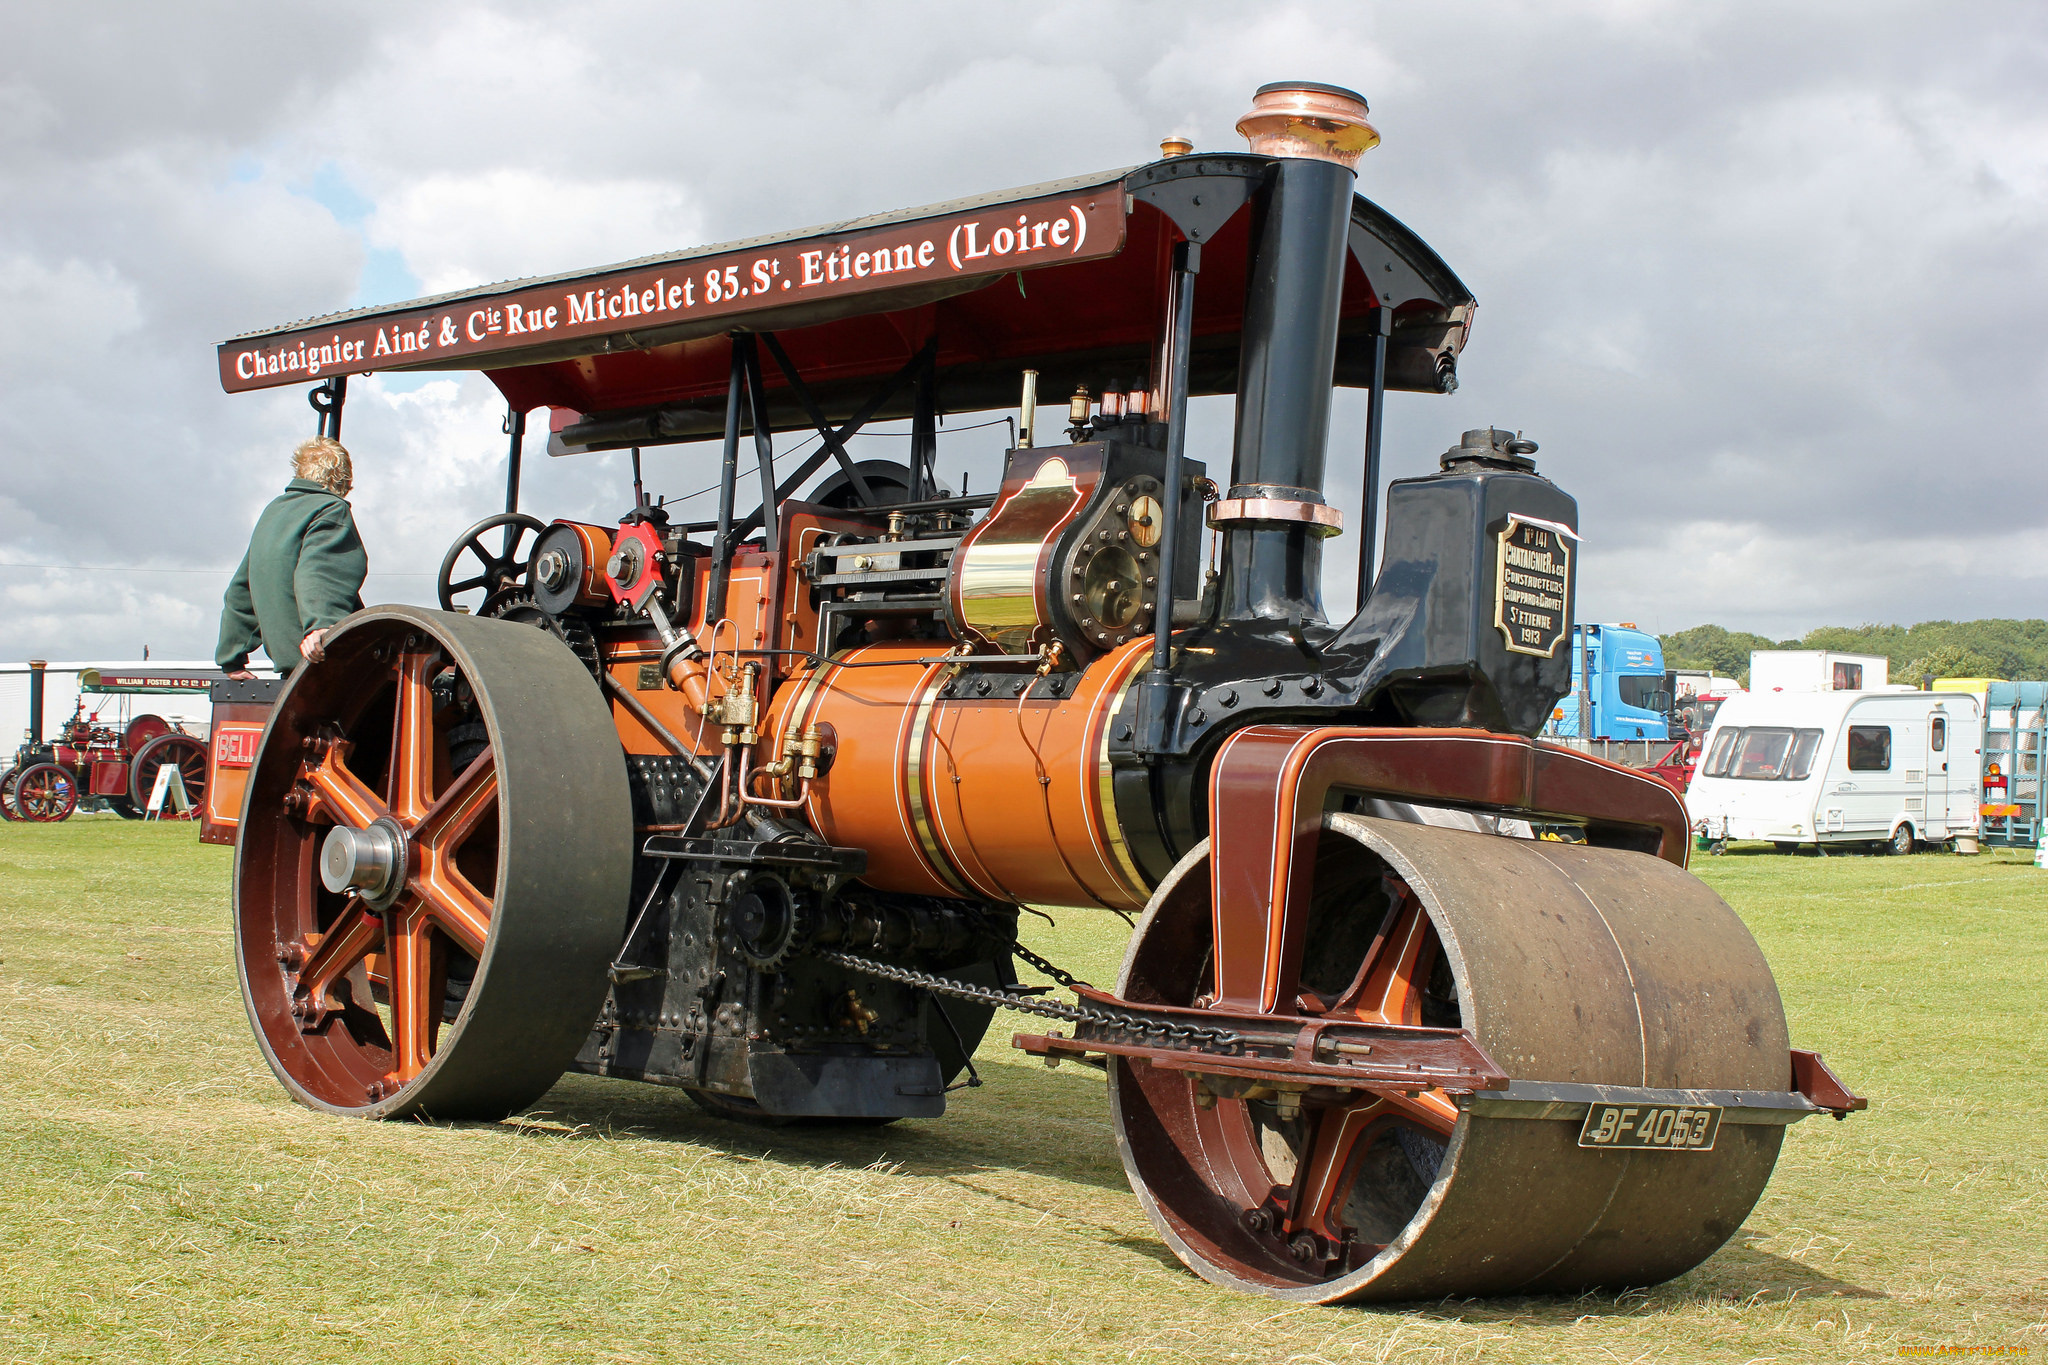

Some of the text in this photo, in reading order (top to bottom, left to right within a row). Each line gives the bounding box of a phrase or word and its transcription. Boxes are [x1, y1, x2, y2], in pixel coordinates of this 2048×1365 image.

[235, 335, 365, 380] Chataignier
[371, 320, 430, 358] Ainé
[437, 316, 459, 347] &
[504, 303, 558, 336] Rue
[564, 277, 696, 326] Michelet
[798, 244, 935, 288] Etienne
[946, 205, 1087, 272] (Loire)
[1535, 530, 1548, 548] 141
[1505, 541, 1552, 574] CHATAIGNIER
[1504, 568, 1563, 594] CONSTRUCTEURS
[1519, 610, 1552, 630] ETIENNE
[1521, 627, 1541, 645] 1913
[147, 678, 171, 686] FOSTER
[1637, 1109, 1711, 1145] 4053
